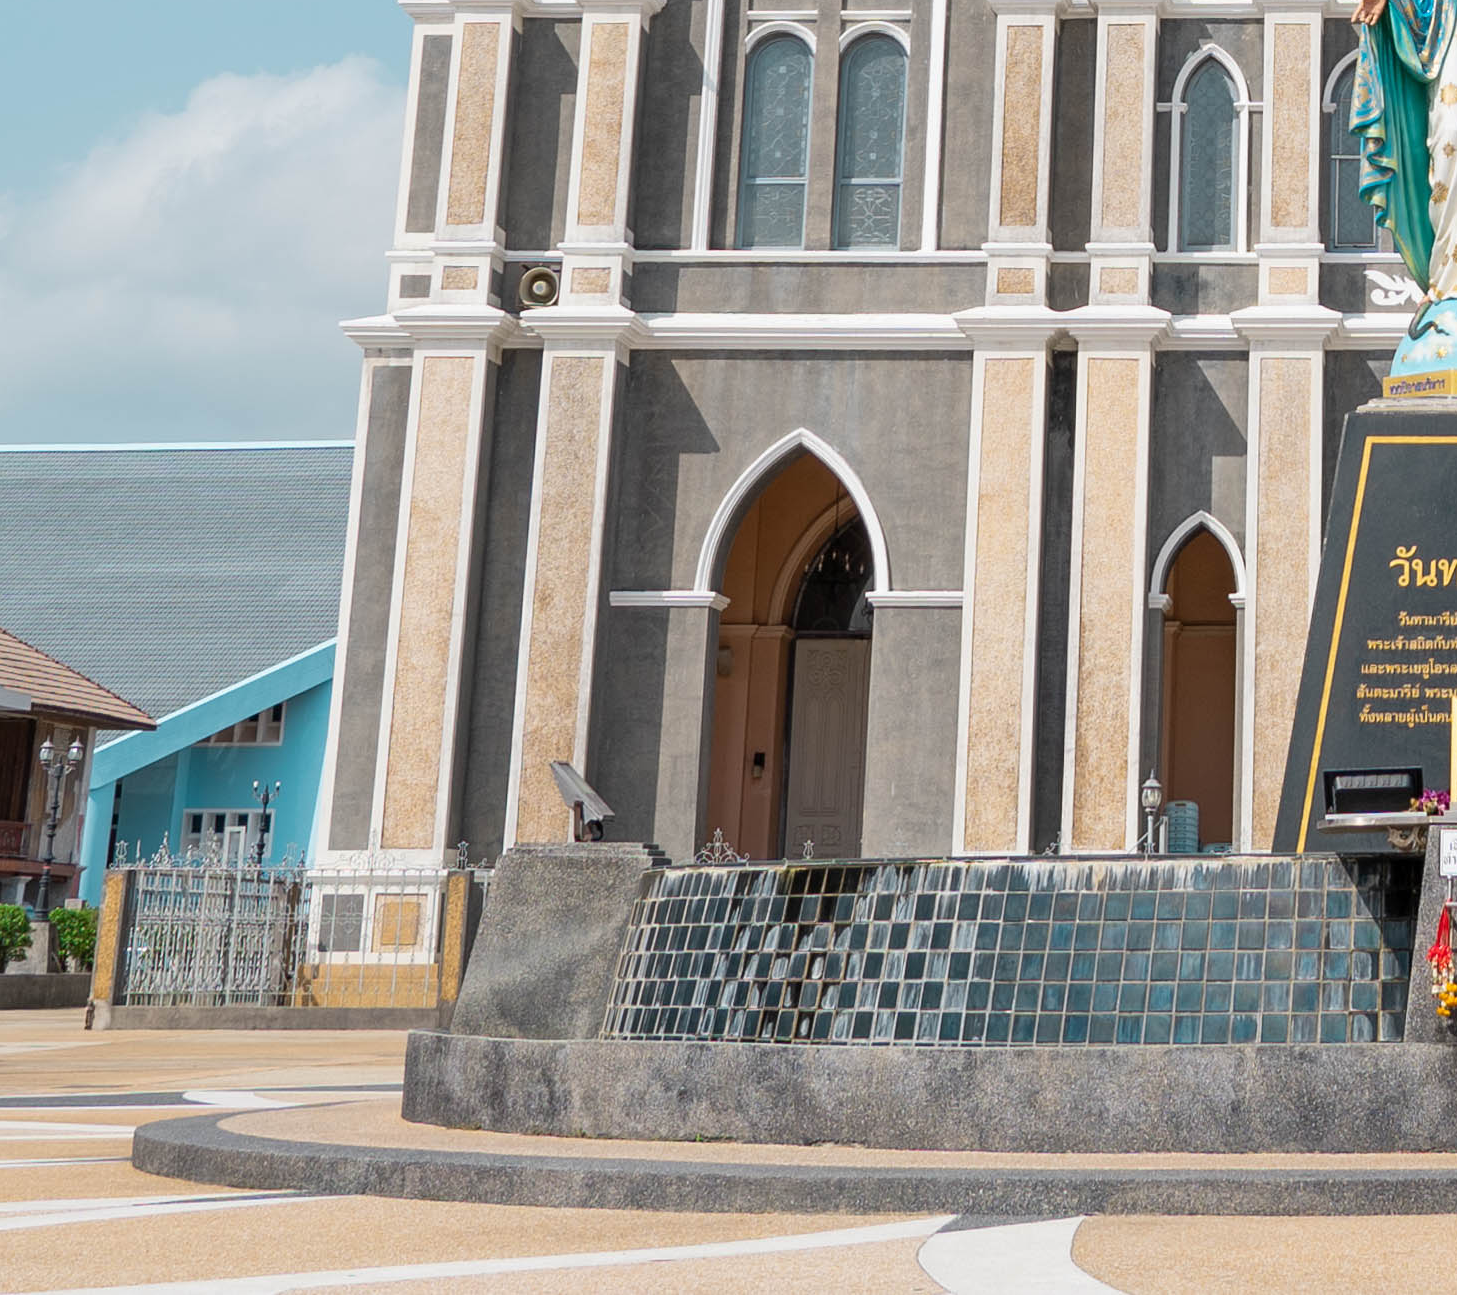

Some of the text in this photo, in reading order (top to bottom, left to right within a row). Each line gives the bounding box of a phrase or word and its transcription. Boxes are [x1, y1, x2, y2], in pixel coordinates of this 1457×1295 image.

[1356, 683, 1420, 699] สันตะมารีย์
